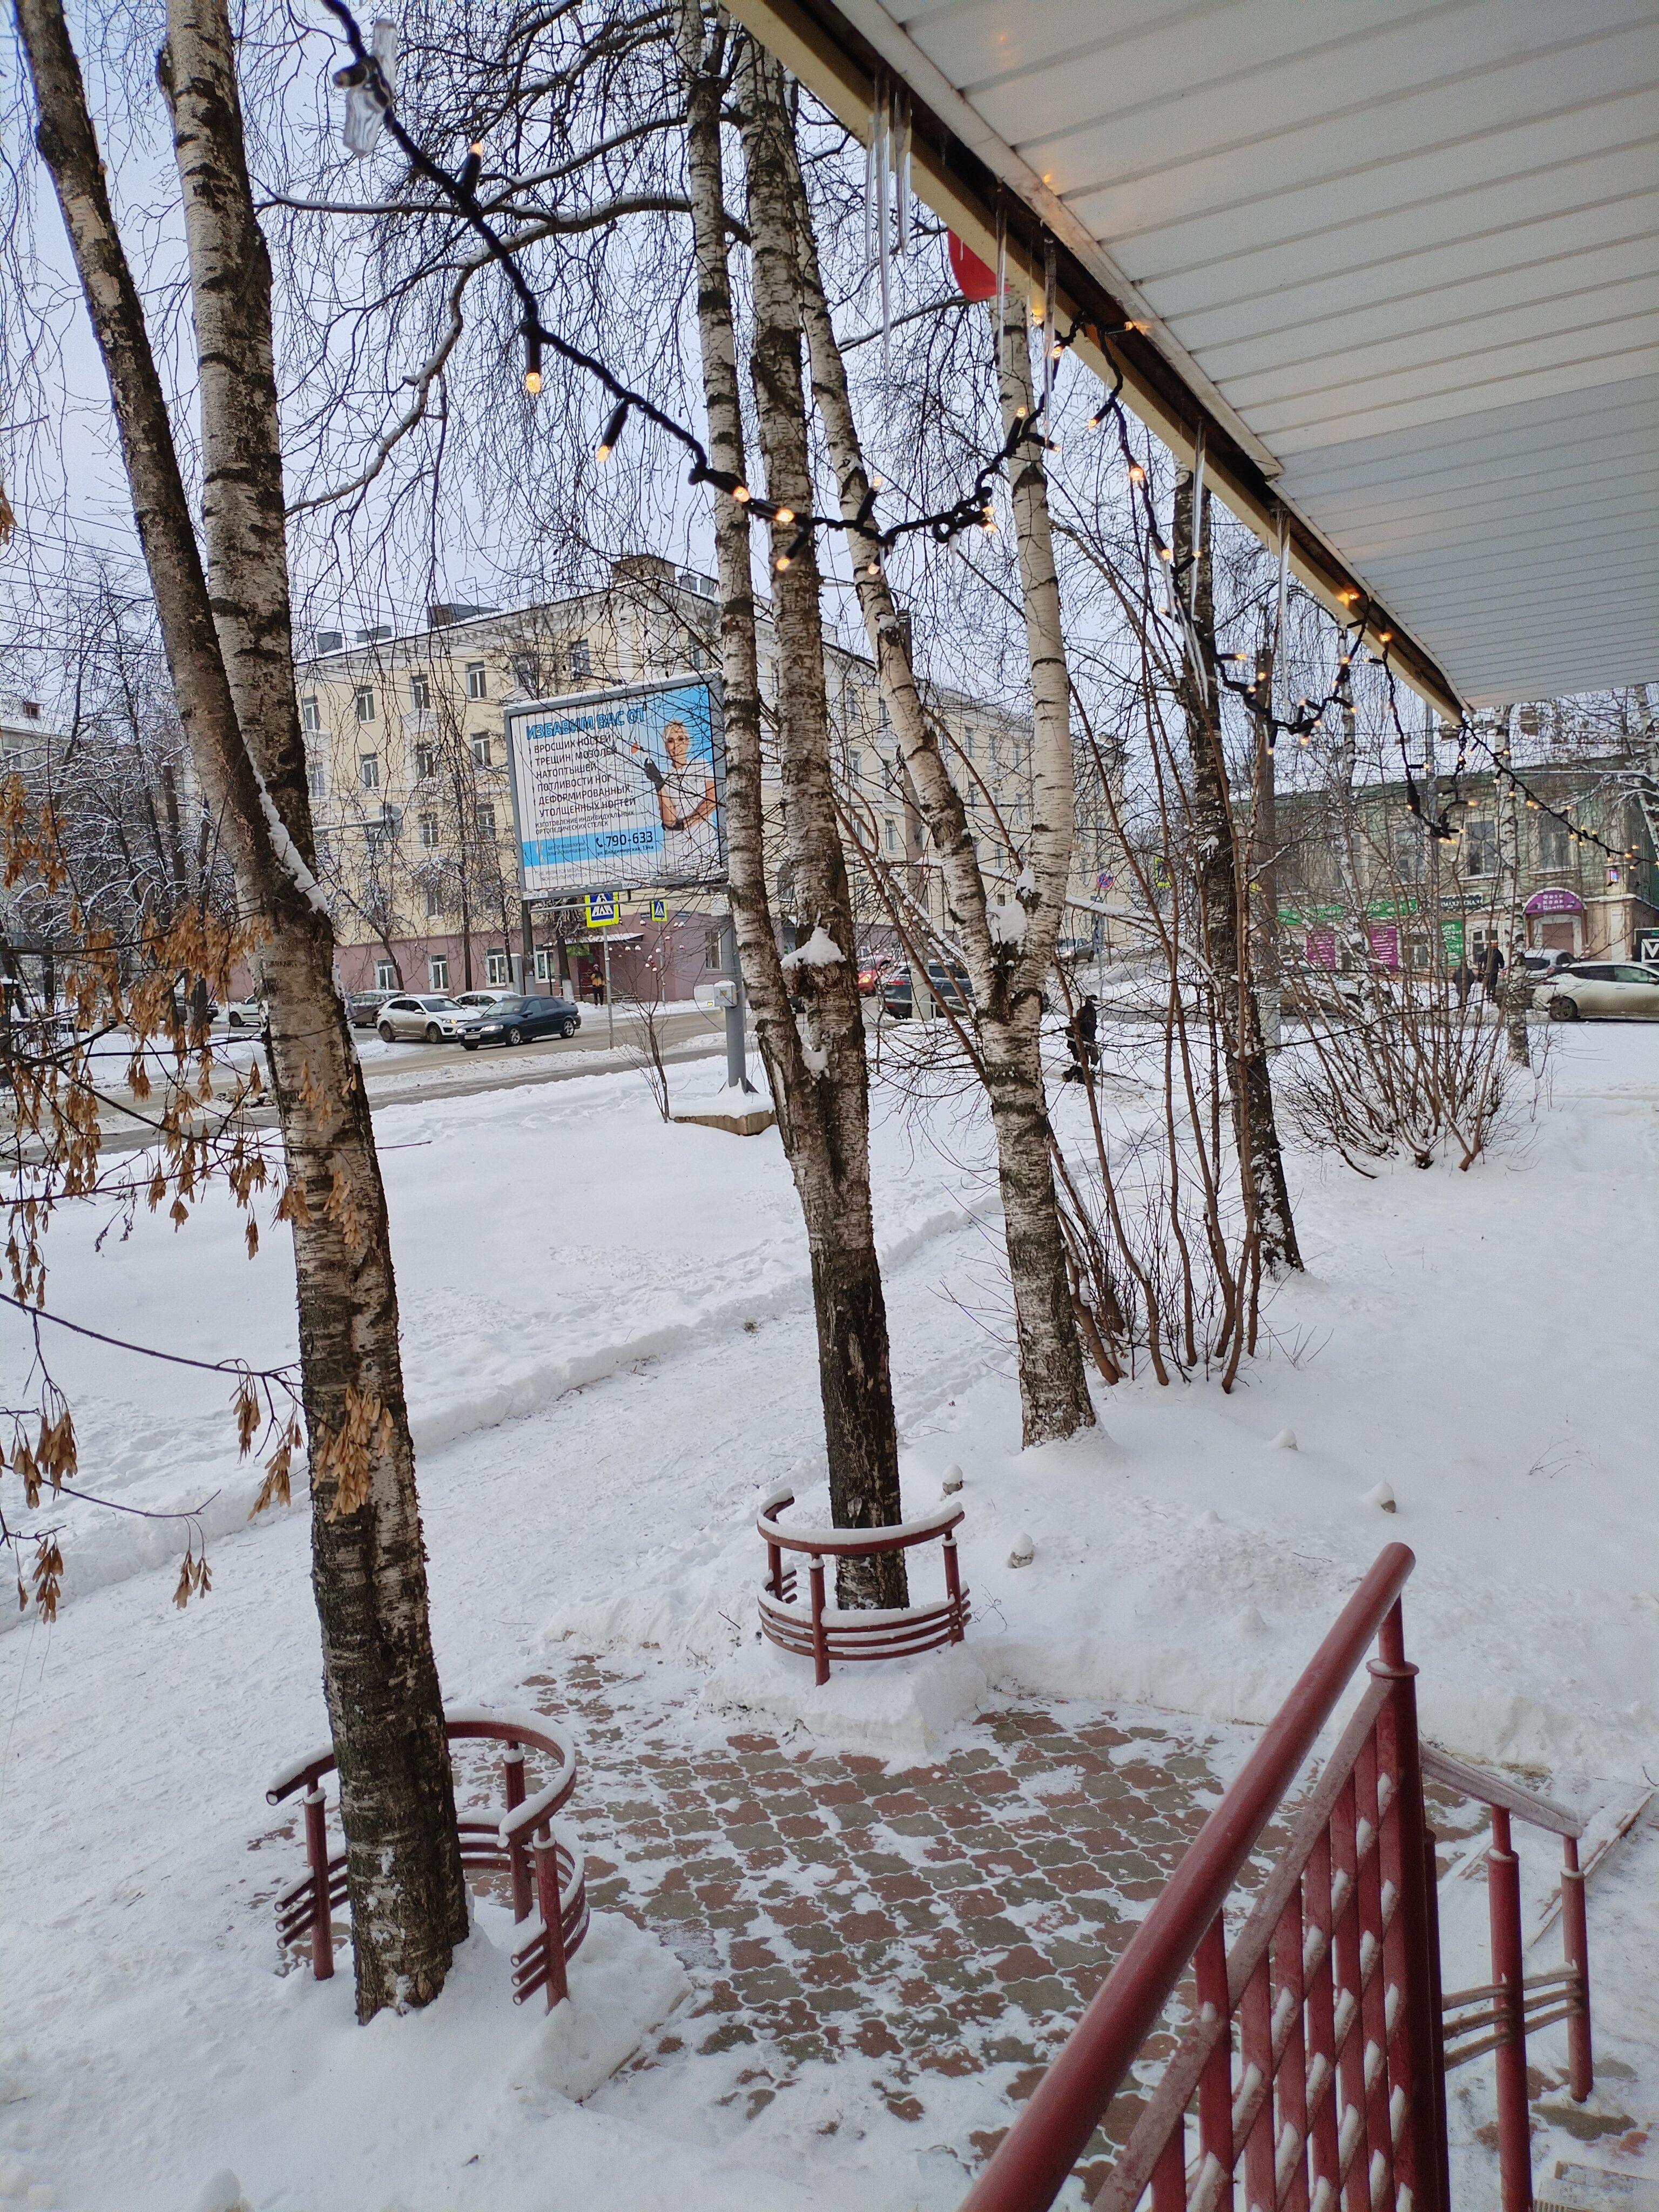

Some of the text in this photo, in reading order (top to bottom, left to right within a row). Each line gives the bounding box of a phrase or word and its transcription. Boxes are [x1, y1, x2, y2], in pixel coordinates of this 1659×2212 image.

[526, 707, 645, 740] ИЗБАВИМ ВАС ОТ
[535, 732, 611, 753] ВРОСШИХ НОГТЕЙ
[536, 761, 597, 779] НАТОПТЫШЕЙ
[537, 774, 611, 792] ПОТЛИВОСТИ НОГ
[539, 785, 633, 806] ДЕФОРМИРОВАННЫХ,
[539, 795, 636, 818] УТОЛЩЕННЫХ НОГТЕЙ
[535, 811, 634, 828] ИЗГОТОВЛЕНИЕ ИНДИВИДУАЛЬНЫХ
[536, 824, 586, 835] ОРТОПЕДИЧЕСКИХ
[606, 831, 653, 847] 790-633
